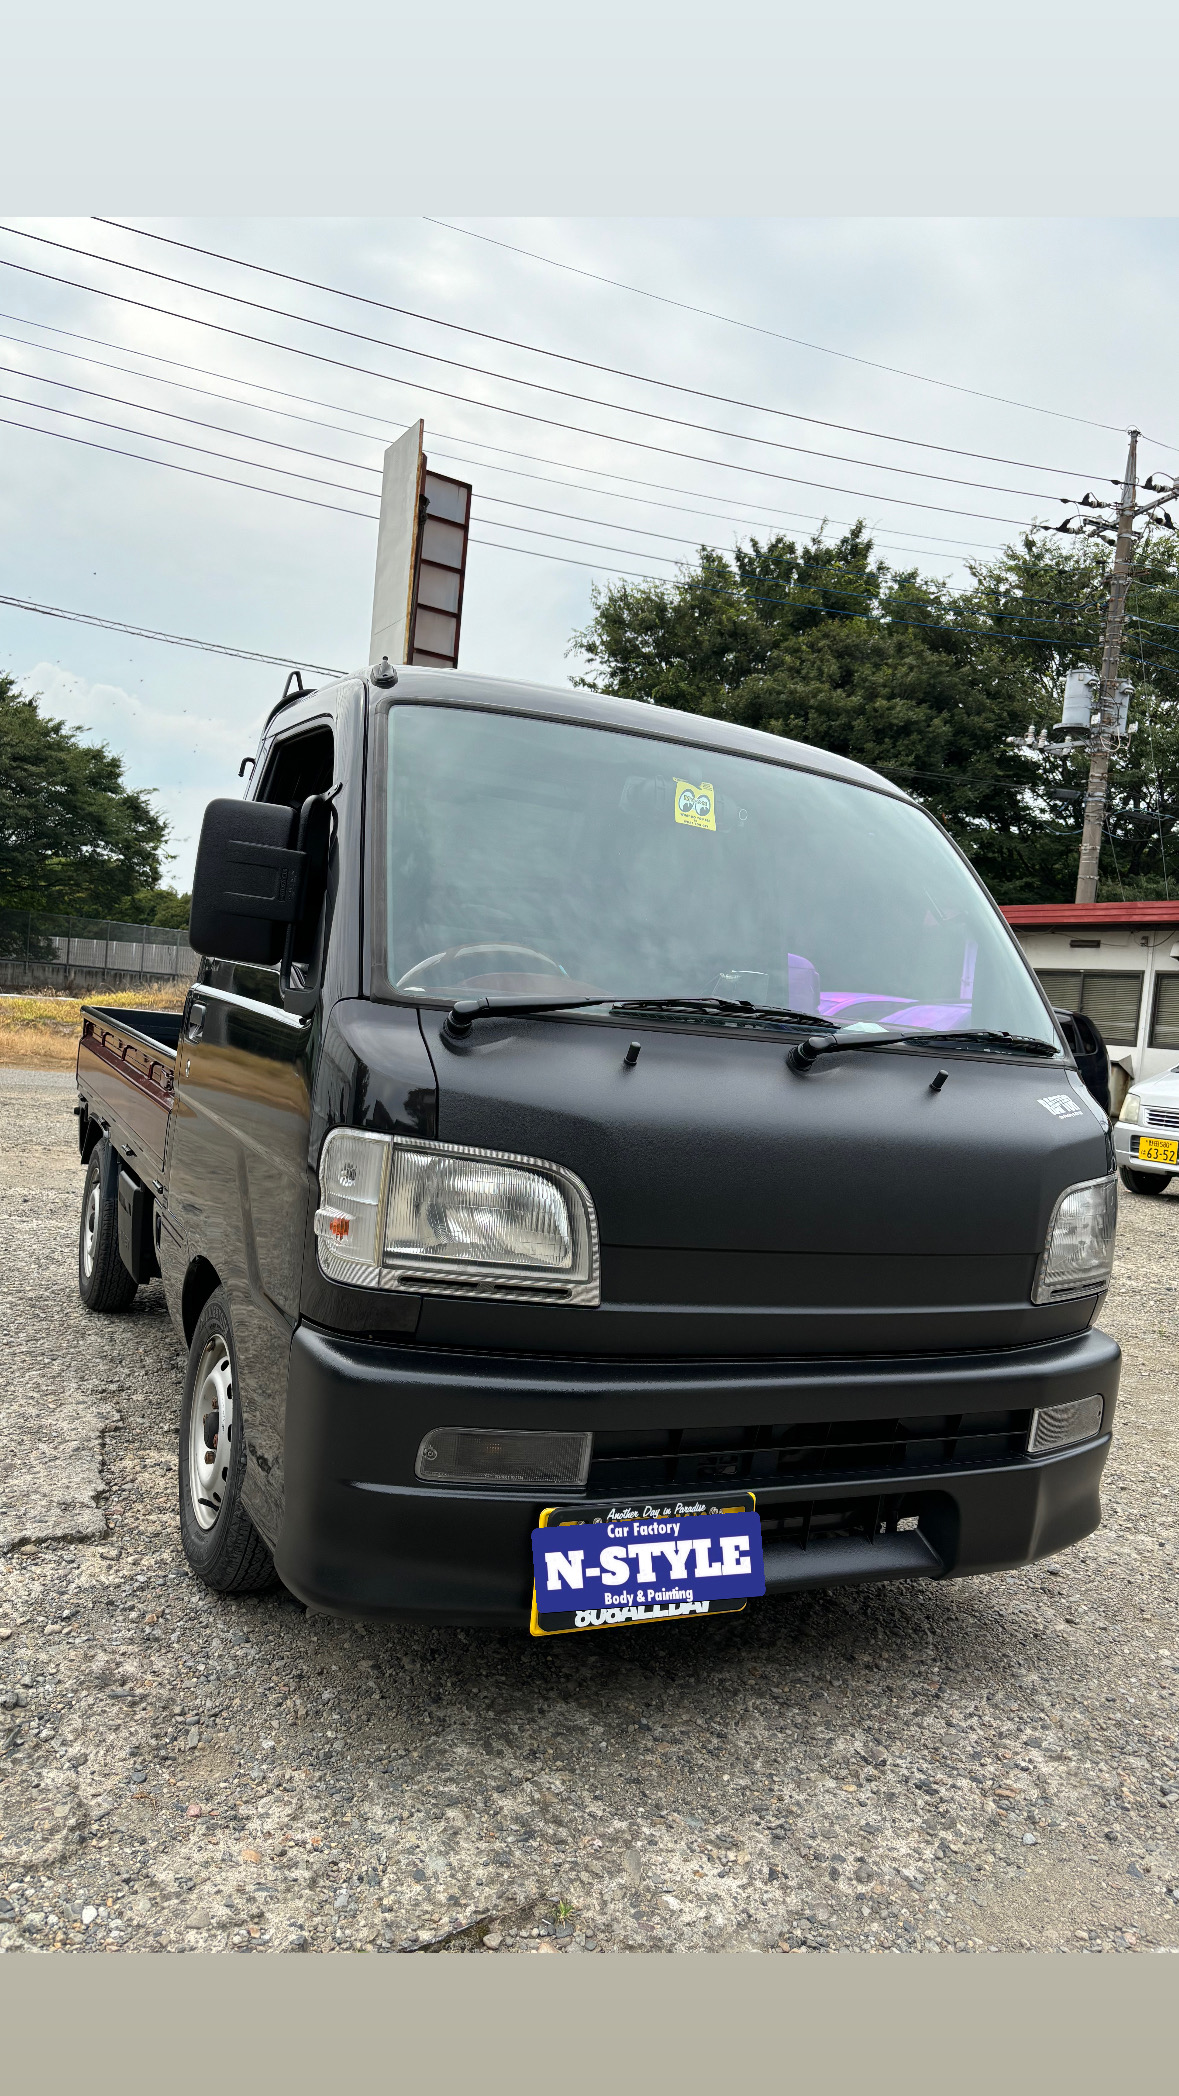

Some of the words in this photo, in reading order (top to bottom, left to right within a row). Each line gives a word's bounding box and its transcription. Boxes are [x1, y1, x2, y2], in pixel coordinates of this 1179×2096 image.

[1147, 1148, 1176, 1162] 63-52
[607, 1507, 639, 1520] Another
[642, 1505, 660, 1519] Day
[662, 1507, 672, 1516] in
[674, 1502, 706, 1514] Paradise
